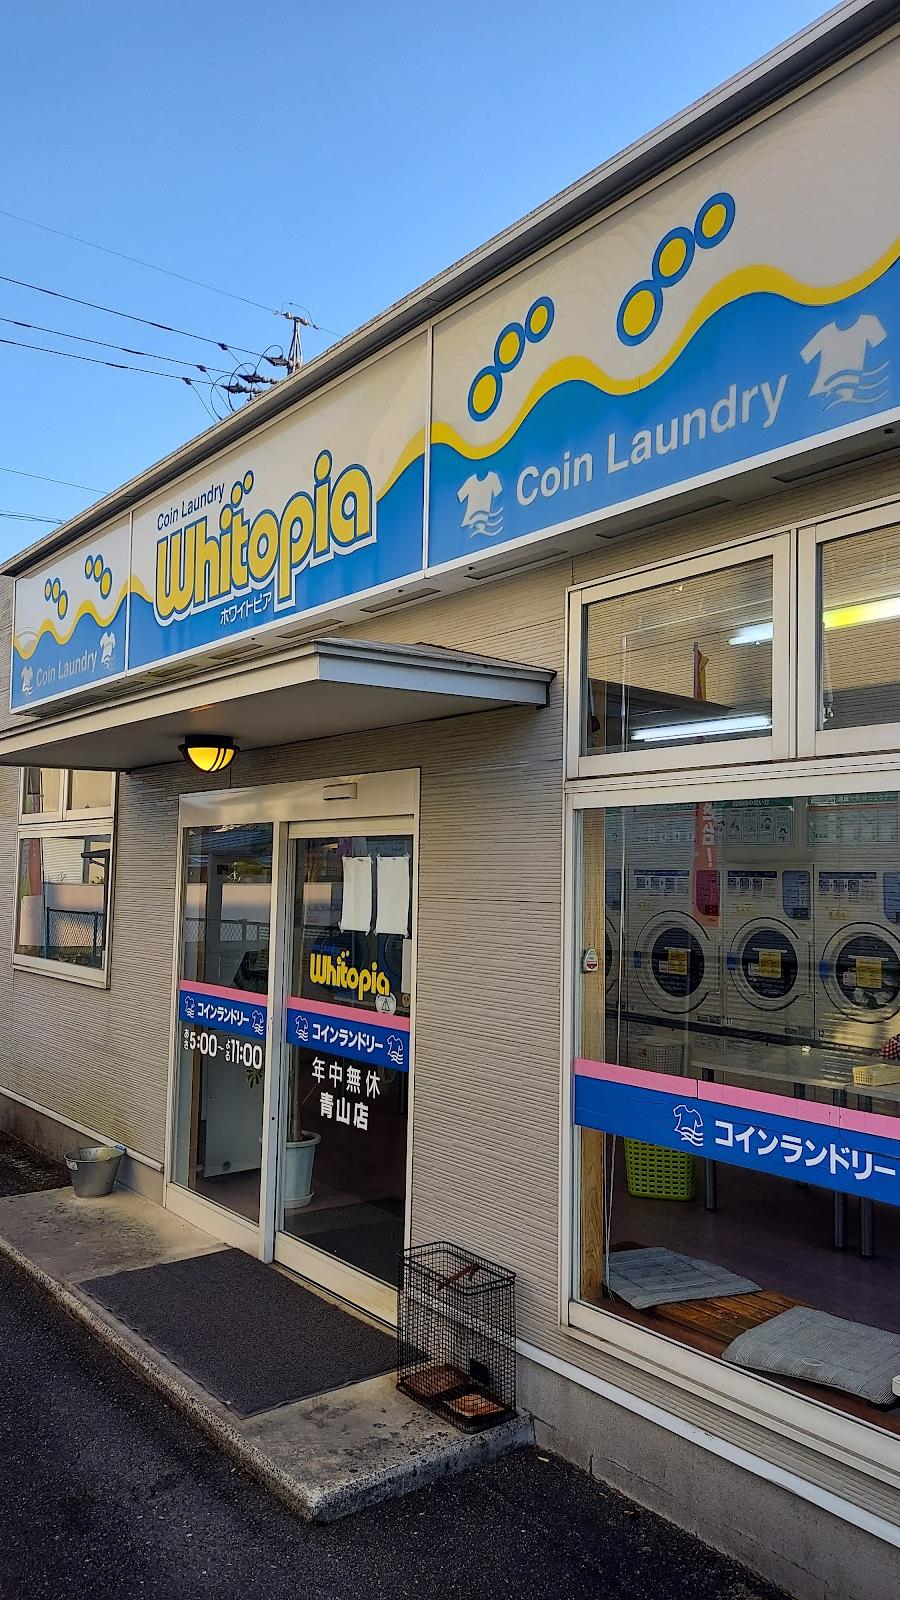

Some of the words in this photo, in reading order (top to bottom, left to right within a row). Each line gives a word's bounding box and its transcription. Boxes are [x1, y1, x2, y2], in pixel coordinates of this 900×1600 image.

[515, 450, 594, 506] Coin
[607, 373, 789, 475] Laundry
[157, 505, 179, 531] Coin
[181, 483, 225, 518] Laundry
[155, 450, 375, 622] Whitopia
[36, 665, 56, 688] Coin
[58, 650, 98, 680] Laundry
[310, 950, 390, 1000] Whitopia
[197, 1002, 250, 1026] コインランドリー
[818, 1029, 825, 1038] 12
[312, 1023, 384, 1053] コインランドリー
[312, 1056, 380, 1099] 年中無休
[320, 1091, 369, 1131] 青山店
[714, 1120, 896, 1180] コインランドリー
